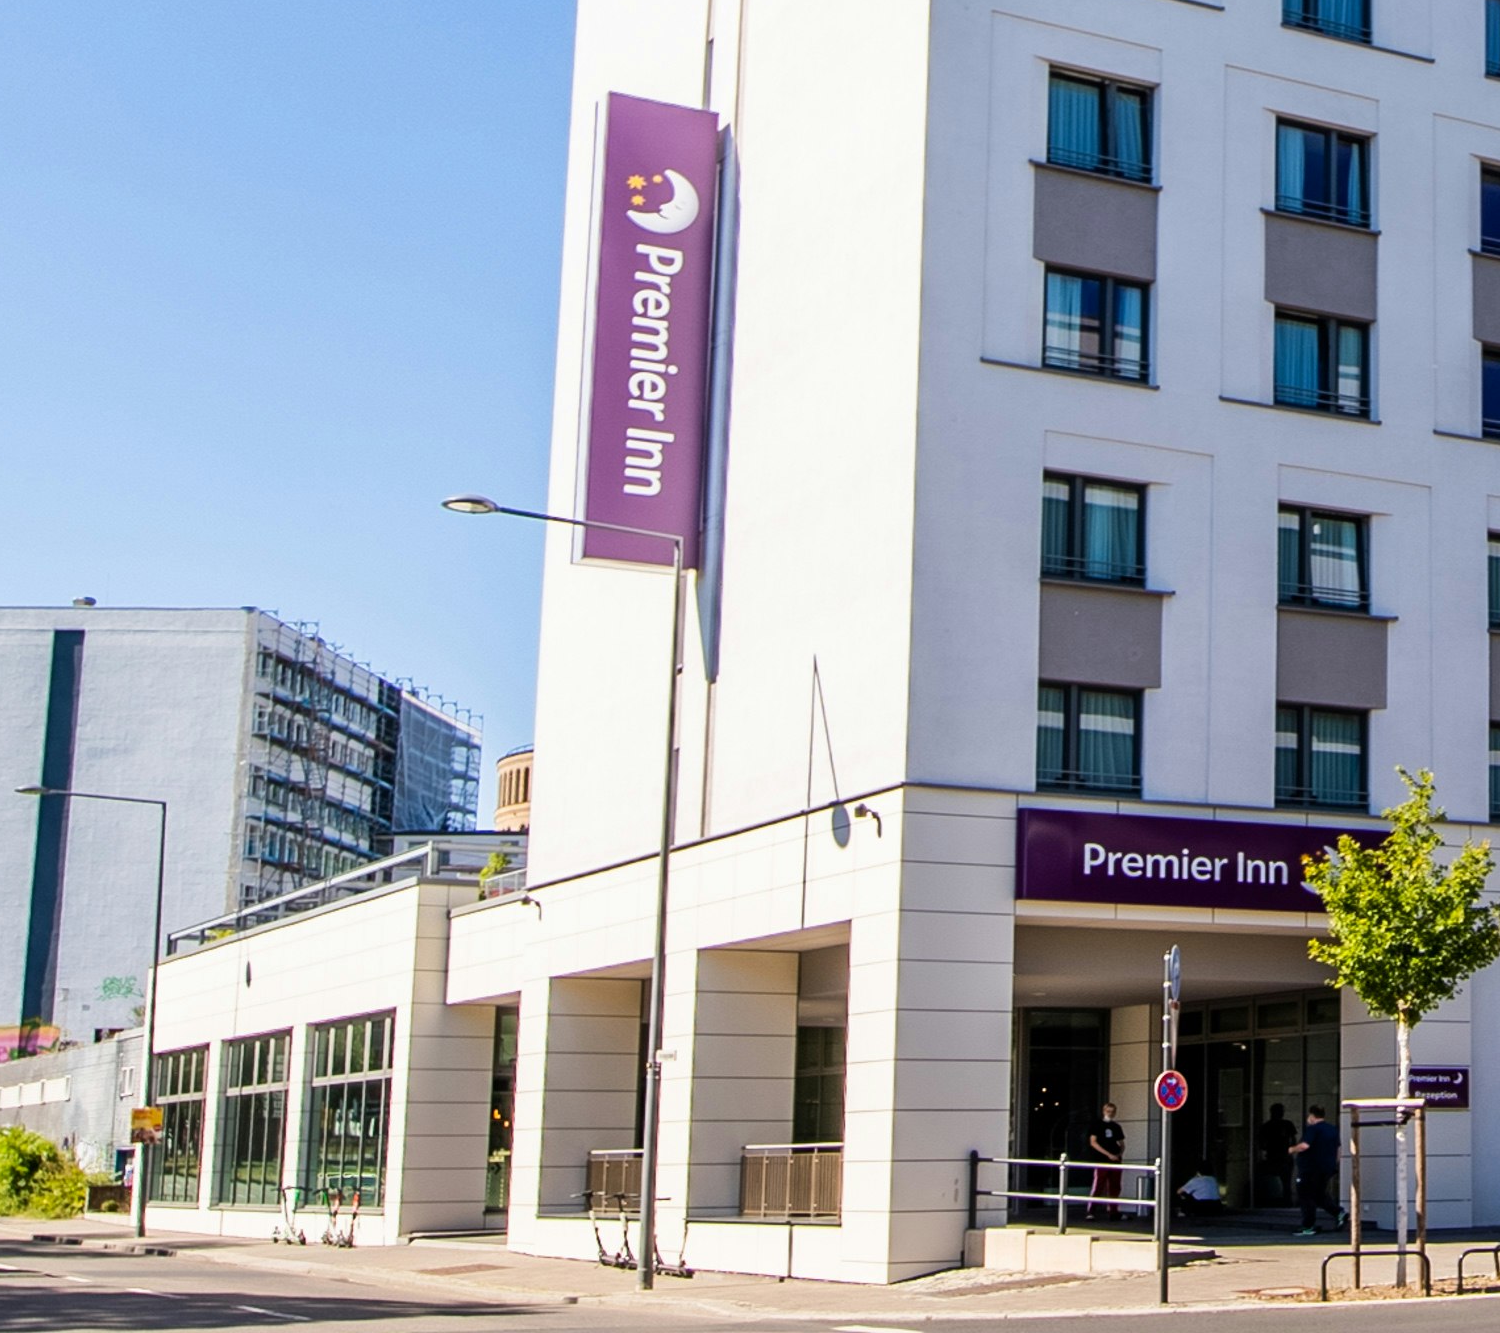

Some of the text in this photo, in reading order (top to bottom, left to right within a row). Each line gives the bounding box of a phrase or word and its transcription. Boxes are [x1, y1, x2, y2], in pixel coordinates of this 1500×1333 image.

[623, 243, 684, 497] Premier Inn
[1083, 842, 1289, 885] Premier Inn
